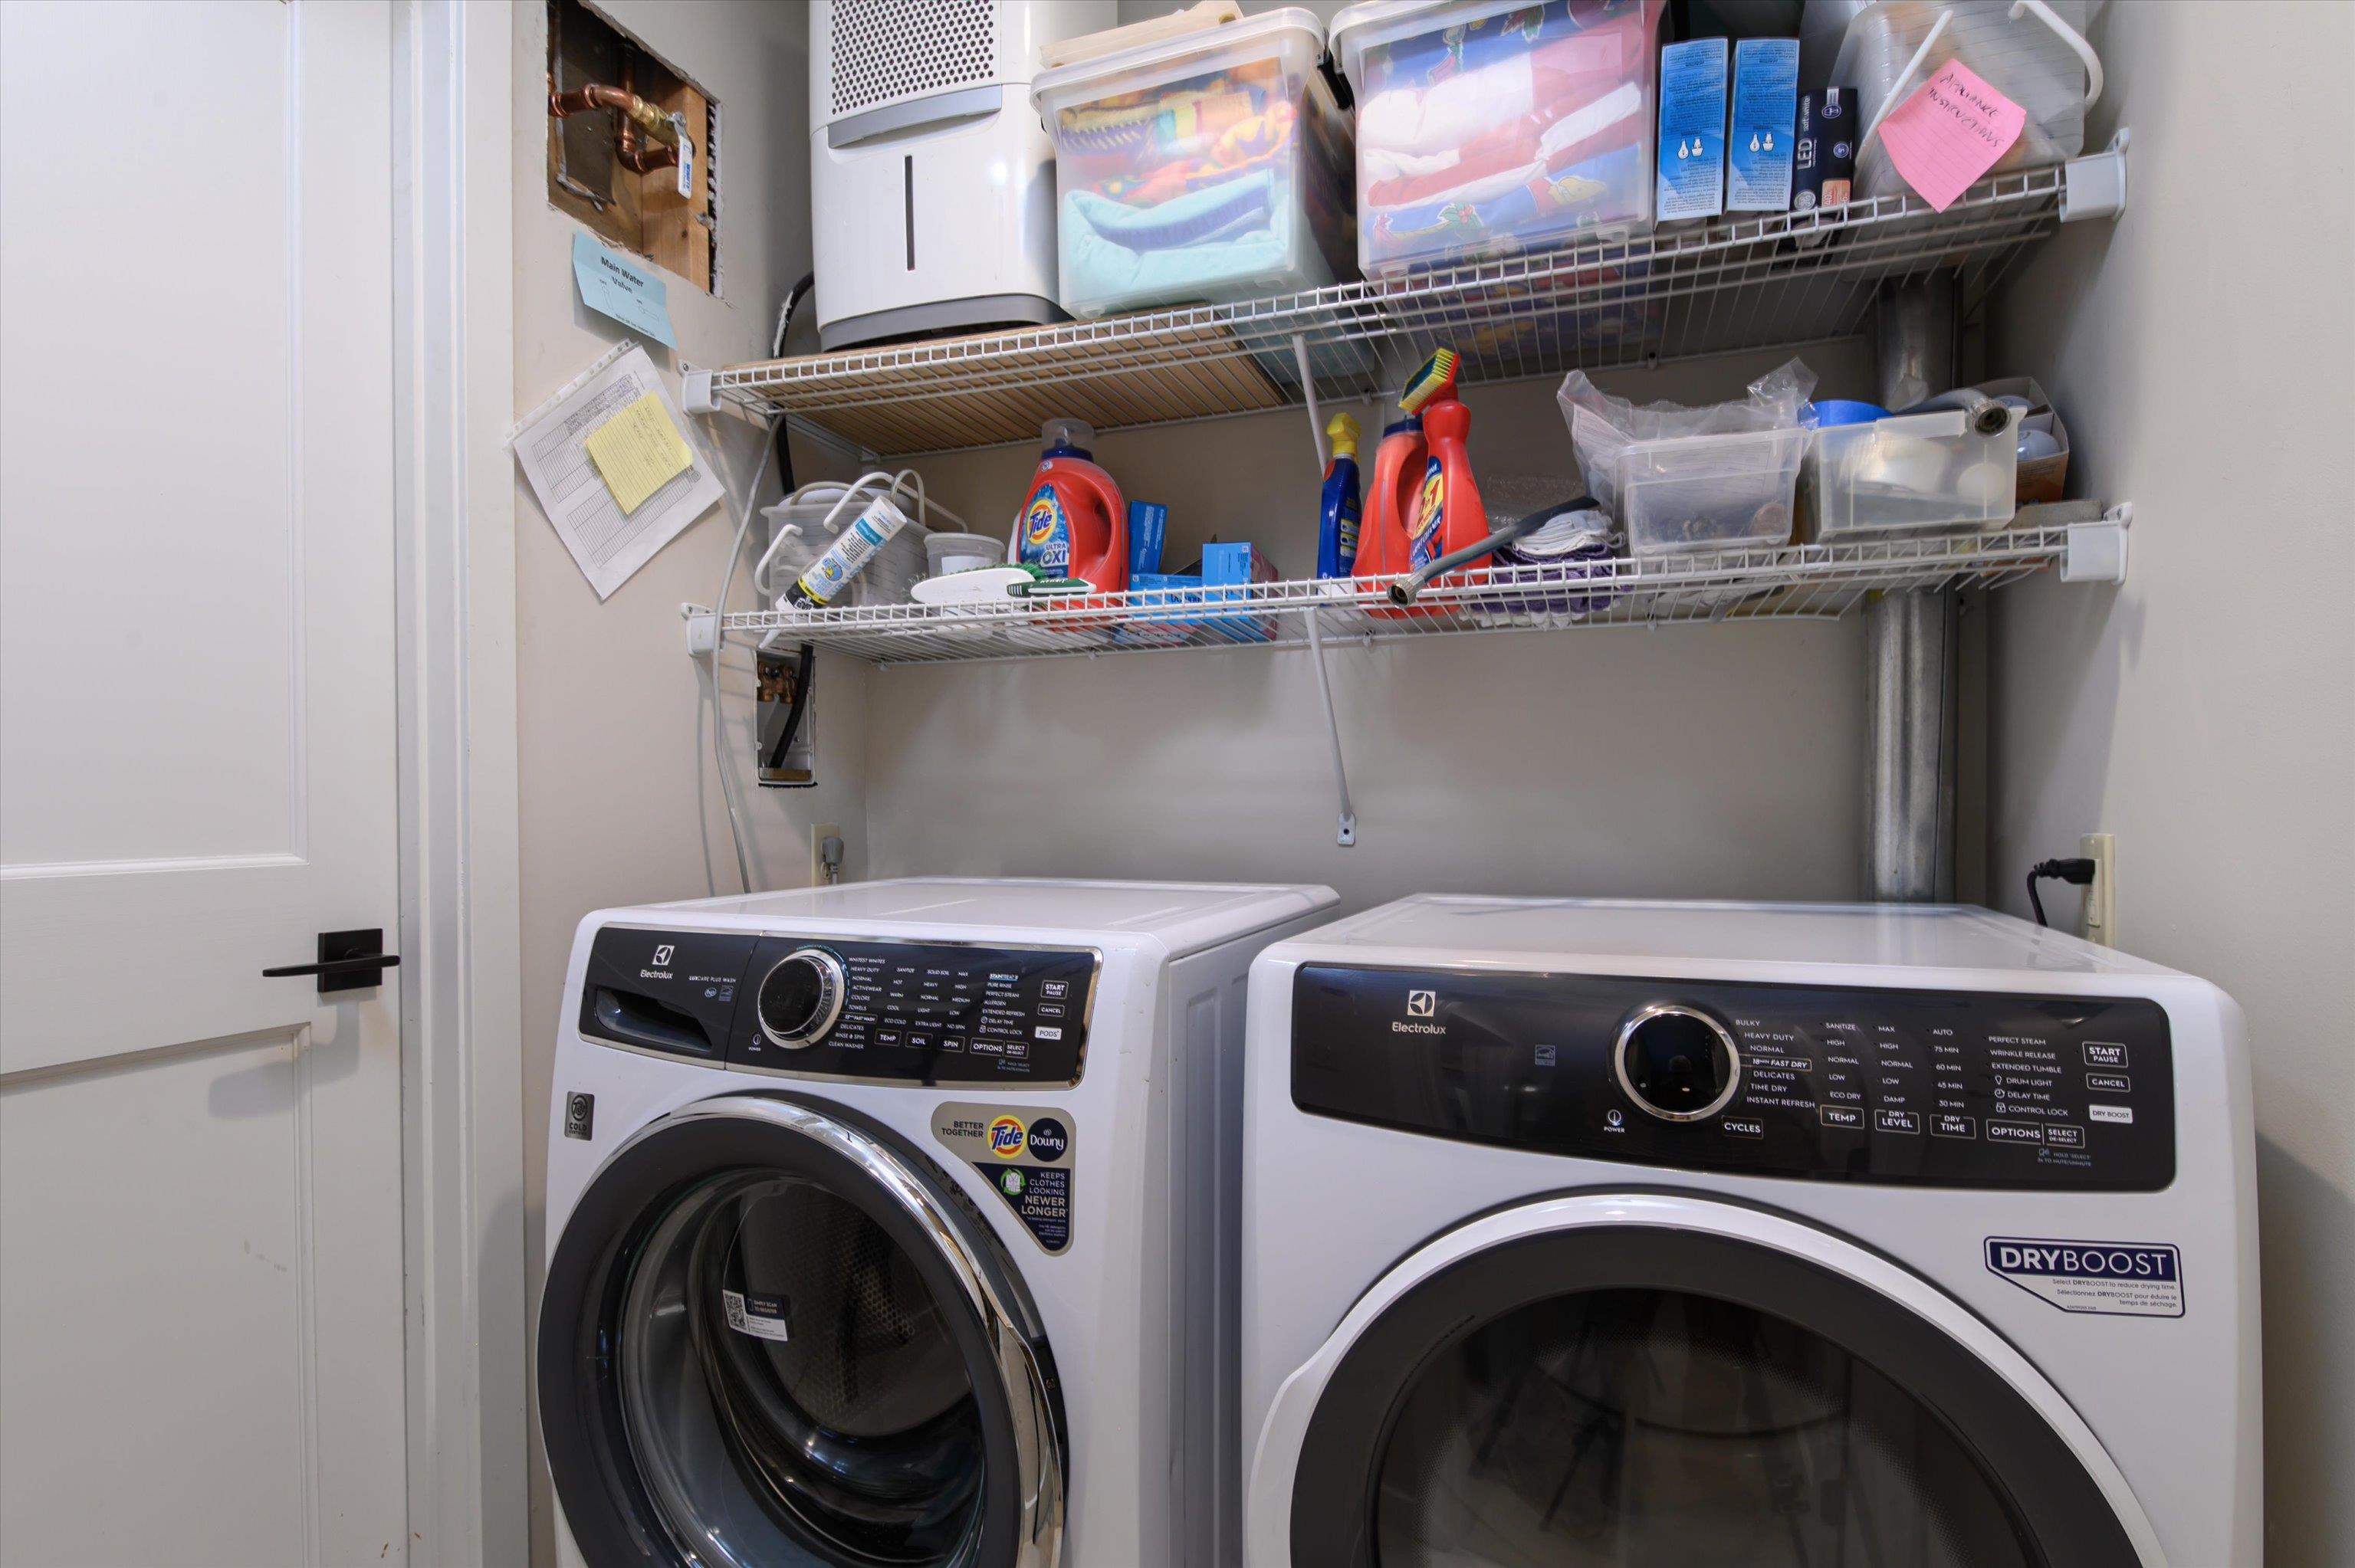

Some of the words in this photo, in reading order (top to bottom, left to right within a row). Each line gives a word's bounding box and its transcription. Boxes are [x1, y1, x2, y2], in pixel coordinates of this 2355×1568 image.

[1940, 74, 2000, 118] APPLIANCE
[1927, 87, 2004, 147] INSTRUCTIONS
[1797, 138, 1813, 170] LED
[601, 256, 620, 274] Main
[621, 268, 644, 287] Water
[612, 276, 632, 293] Valve
[1030, 510, 1053, 538] Tide
[1043, 550, 1066, 564] OXI
[641, 969, 672, 979] Electrolux
[1045, 983, 1065, 992] START
[1392, 1022, 1446, 1035] Electrolux
[1744, 1032, 1770, 1041] HEAVY
[973, 1043, 1003, 1052] OPTIONS
[1750, 1045, 1785, 1054] NORMAL
[2089, 1047, 2121, 1057] START
[1990, 1049, 2023, 1058] WRINKLE
[2025, 1051, 2056, 1060] RELEASE
[1771, 1059, 1789, 1068] FAST
[1791, 1061, 1808, 1069] DRY
[1828, 1056, 1859, 1064] NORMAL
[1880, 1060, 1913, 1068] NORMAL
[1992, 1063, 2031, 1071] EXTENDED
[2032, 1065, 2062, 1074] TUMBLE
[1753, 1071, 1795, 1081] DELICATES
[2092, 1078, 2125, 1087] CANCEL
[1771, 1084, 1788, 1093] DRY
[2007, 1091, 2031, 1100] DELAY
[1746, 1097, 1779, 1105] INSTANT
[1782, 1099, 1815, 1108] REFRESH
[2008, 1105, 2046, 1115] CONTROL
[1829, 1113, 1856, 1122] TEMP
[1882, 1117, 1913, 1128] LEVEL
[569, 1122, 587, 1131] COLD
[954, 1120, 984, 1130] BETTER
[1724, 1122, 1761, 1133] CYCLES
[1940, 1122, 1966, 1133] TIME
[941, 1127, 984, 1138] TOGETHER
[1992, 1127, 2041, 1138] OPTIONS
[2048, 1128, 2077, 1137] SELECT
[991, 1125, 1023, 1151] Tide
[1030, 1134, 1064, 1150] Downy
[1040, 1172, 1065, 1180] KEEPS
[1030, 1179, 1065, 1188] CLOTHES
[1029, 1187, 1065, 1196] LOOKING
[1025, 1195, 1065, 1206] NEWER
[2000, 1246, 2166, 1275] DRYBOOST
[2140, 1283, 2160, 1291] drying
[2149, 1300, 2177, 1308] séchage.
